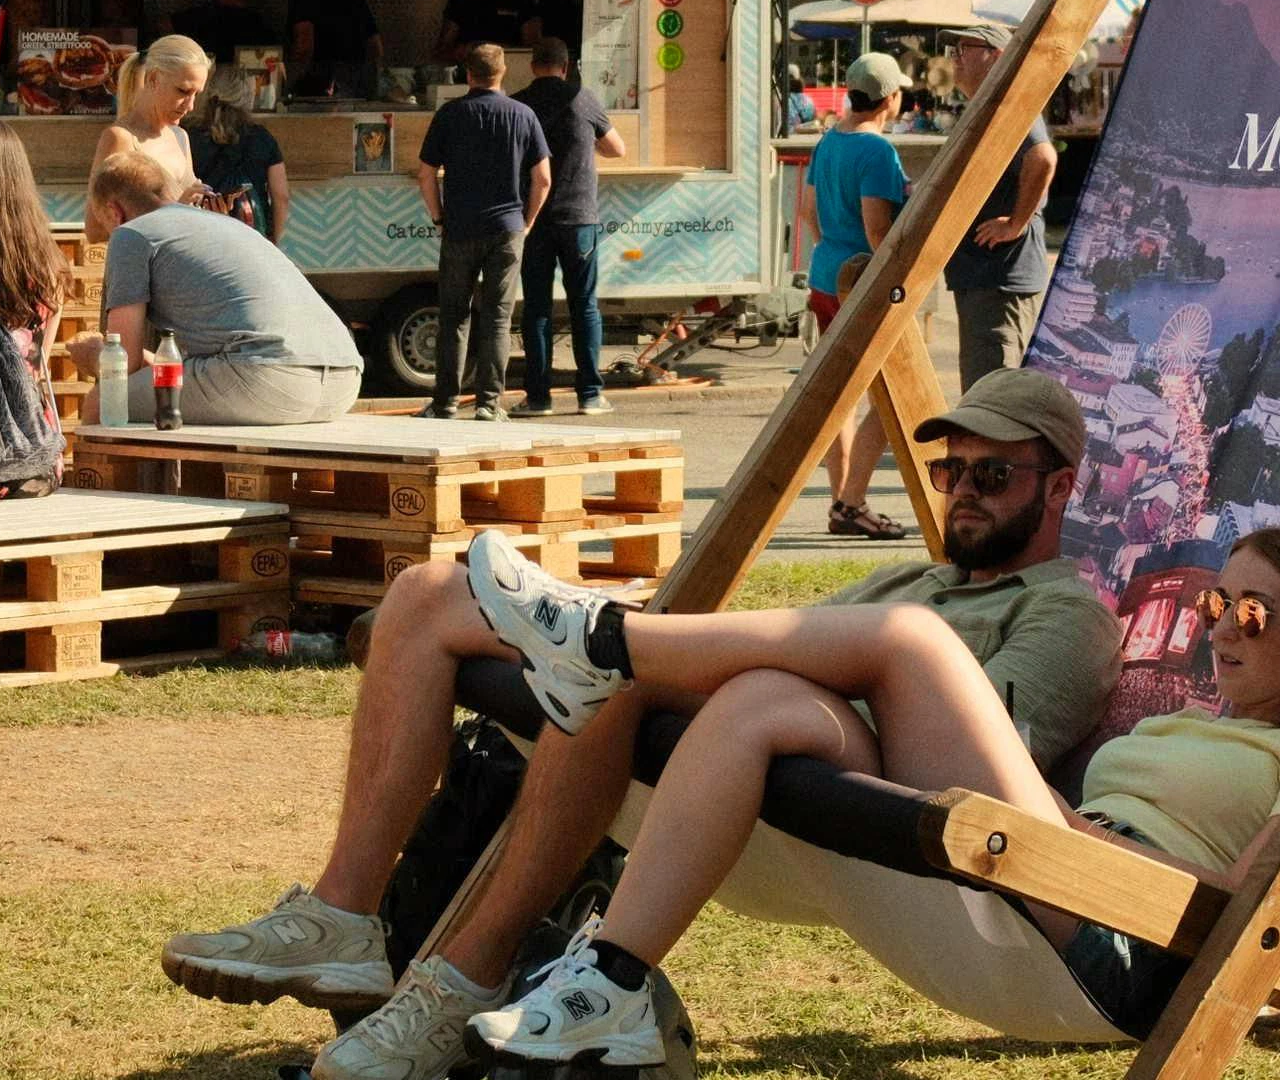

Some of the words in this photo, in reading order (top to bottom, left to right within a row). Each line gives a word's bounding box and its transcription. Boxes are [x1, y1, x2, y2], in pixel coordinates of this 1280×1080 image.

[21, 31, 80, 42] HOMEMADE
[22, 41, 45, 50] GREEK
[46, 41, 92, 50] STREETFOOD
[397, 492, 420, 510] EPAL
